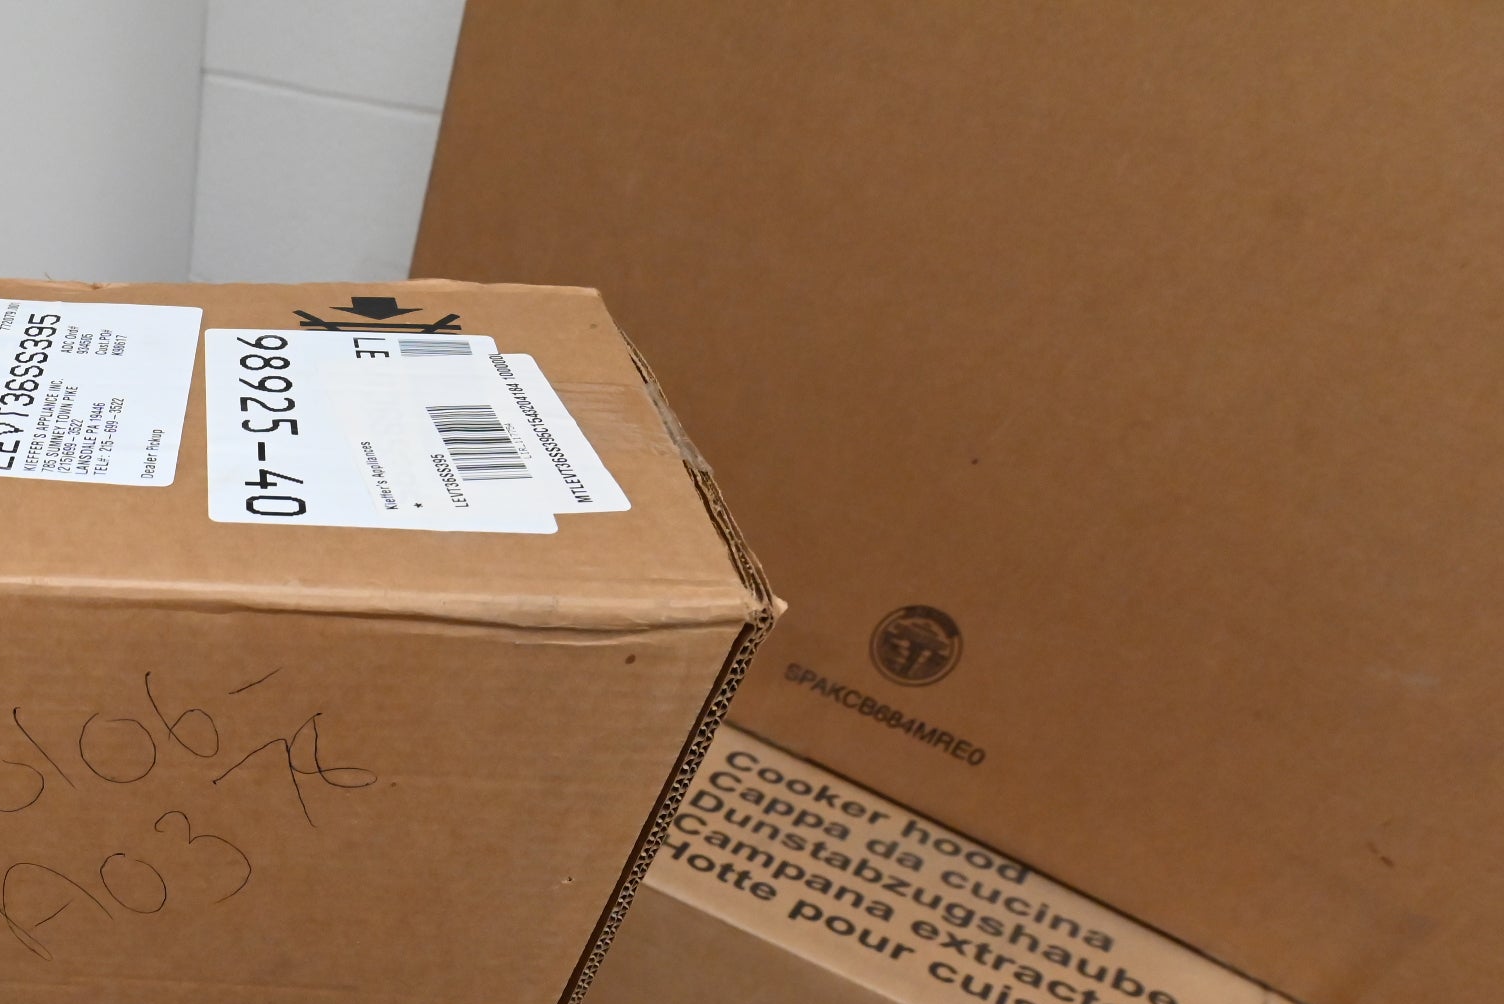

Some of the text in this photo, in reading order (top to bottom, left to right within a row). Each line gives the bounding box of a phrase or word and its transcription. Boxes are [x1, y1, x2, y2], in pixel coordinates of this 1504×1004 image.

[352, 336, 390, 359] LE
[36, 394, 59, 431] APPLIANCE
[56, 403, 73, 423] TOWN
[62, 386, 78, 401] PIKE
[237, 334, 307, 517] 98925-40
[141, 453, 157, 478] Dealer
[361, 442, 384, 478] Appliances
[431, 454, 468, 508] LEVT36SS395
[725, 750, 1031, 886] Cooker hood
[673, 812, 896, 924] Campana
[707, 770, 1115, 953] Cappa da cucina
[662, 834, 778, 902] Hotte
[788, 898, 916, 962] pour
